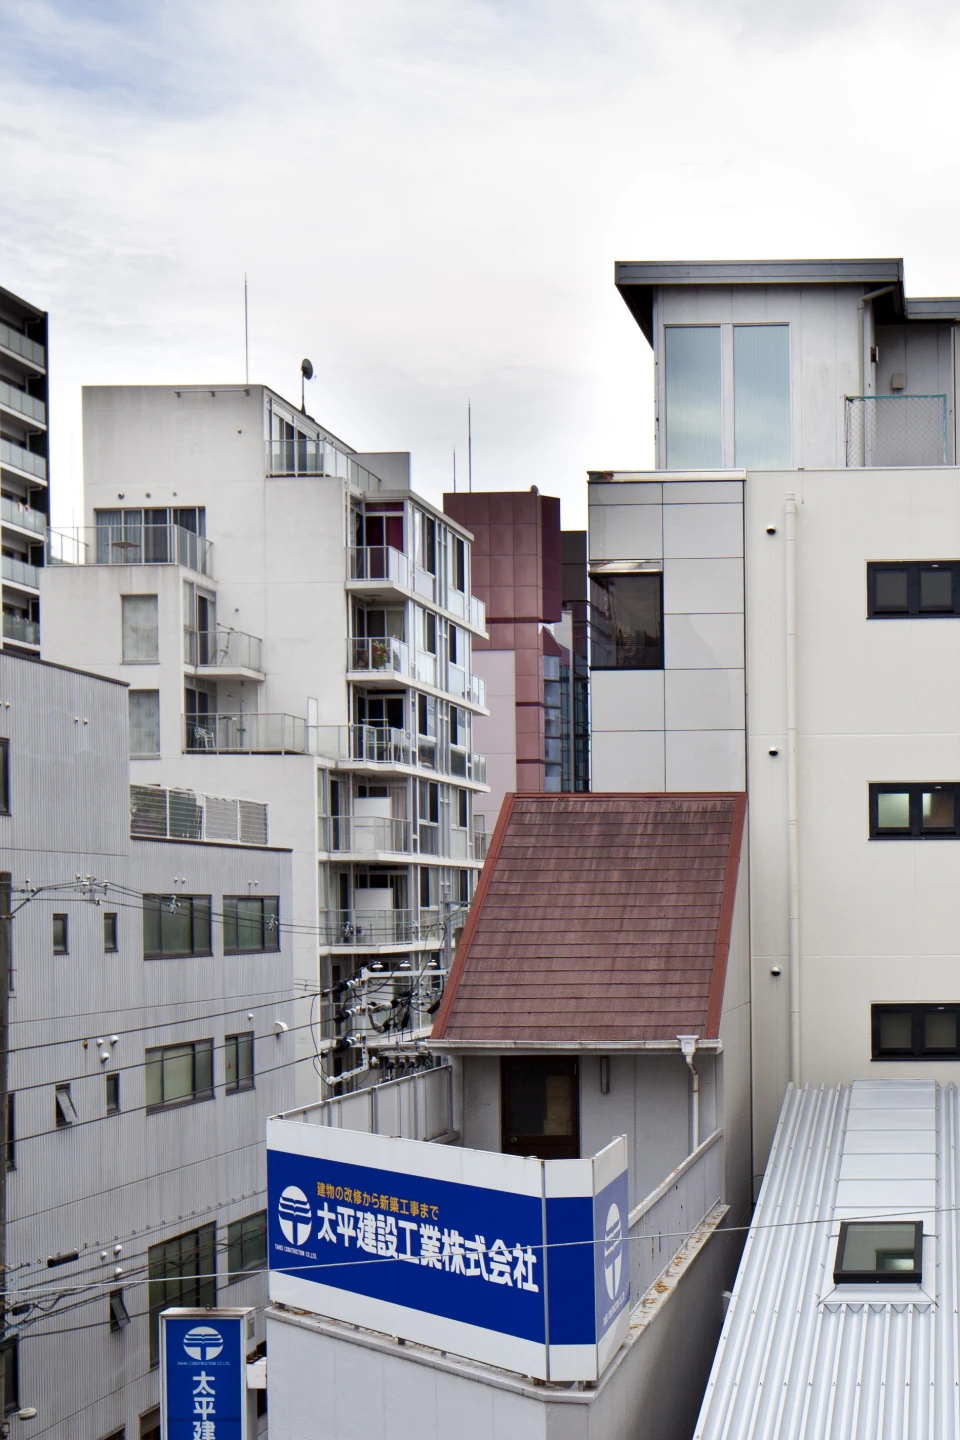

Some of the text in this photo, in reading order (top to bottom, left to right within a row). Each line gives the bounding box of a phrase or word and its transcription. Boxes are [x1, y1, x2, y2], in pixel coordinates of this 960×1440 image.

[316, 1181, 439, 1221] 建物の改修から新築工事まで
[317, 1201, 539, 1293] 太平建設工業株式会社
